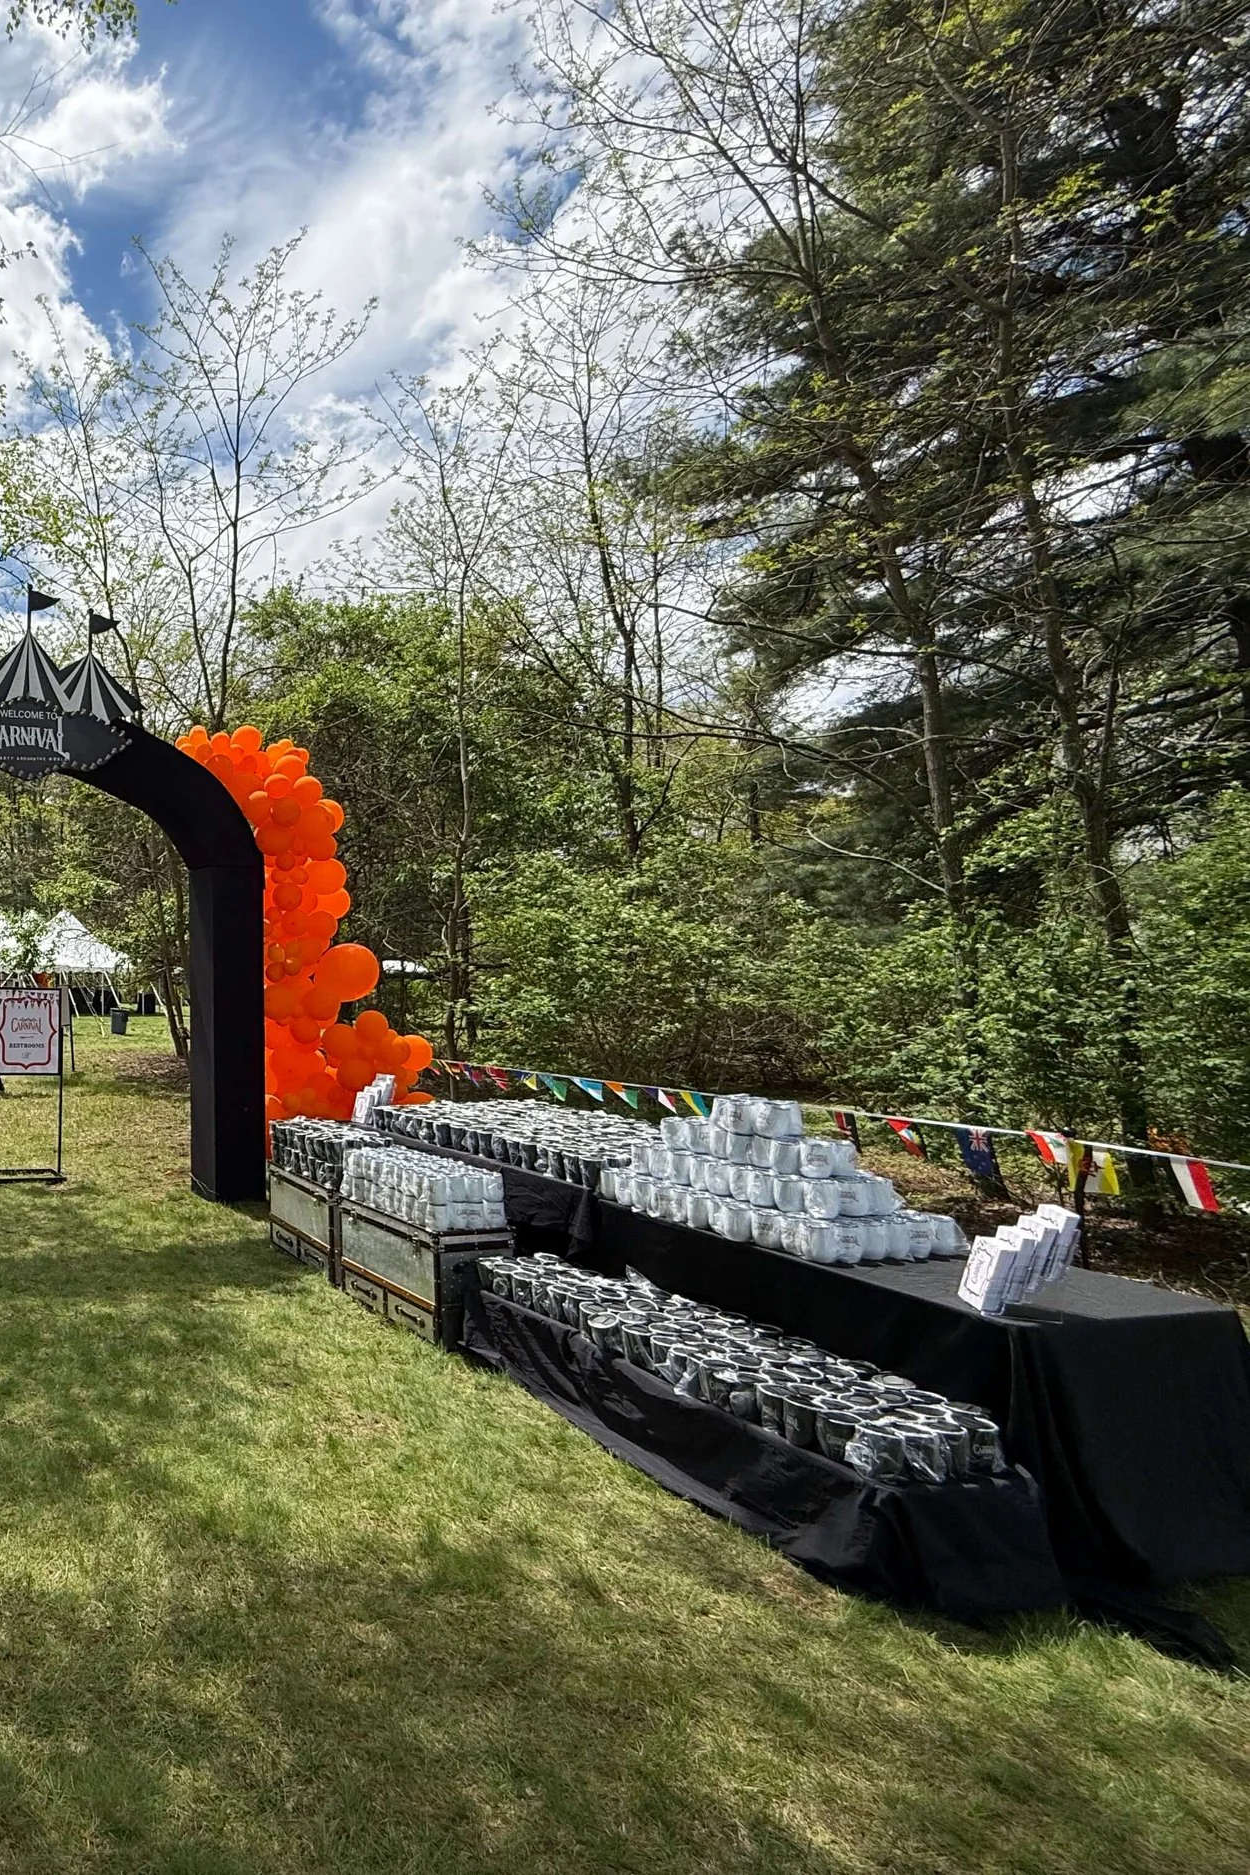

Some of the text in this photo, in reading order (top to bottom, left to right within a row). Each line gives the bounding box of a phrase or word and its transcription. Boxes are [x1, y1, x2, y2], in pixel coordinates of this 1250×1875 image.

[0, 709, 58, 720] WELCOME TO
[11, 1017, 43, 1034] CARNIVAL
